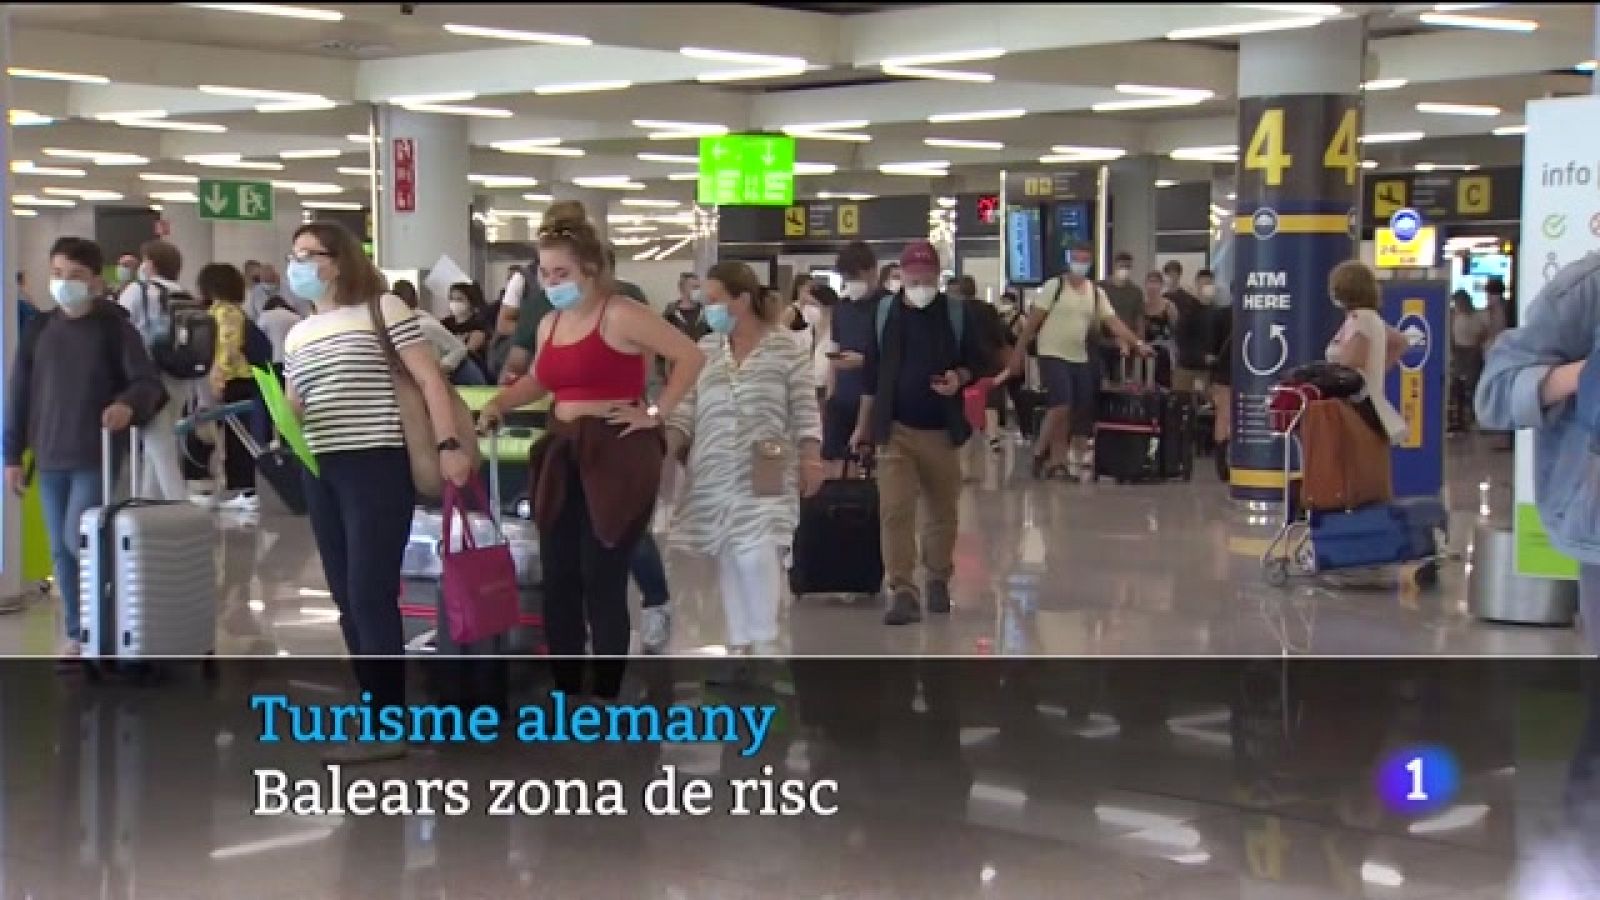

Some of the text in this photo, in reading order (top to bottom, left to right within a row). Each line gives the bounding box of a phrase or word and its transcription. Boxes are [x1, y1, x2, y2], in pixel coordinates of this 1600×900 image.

[1245, 108, 1357, 185] 4 4
[1542, 160, 1591, 186] info
[1465, 184, 1481, 205] C
[841, 209, 853, 227] C
[1246, 271, 1287, 288] ATM
[1243, 294, 1291, 310] HERE
